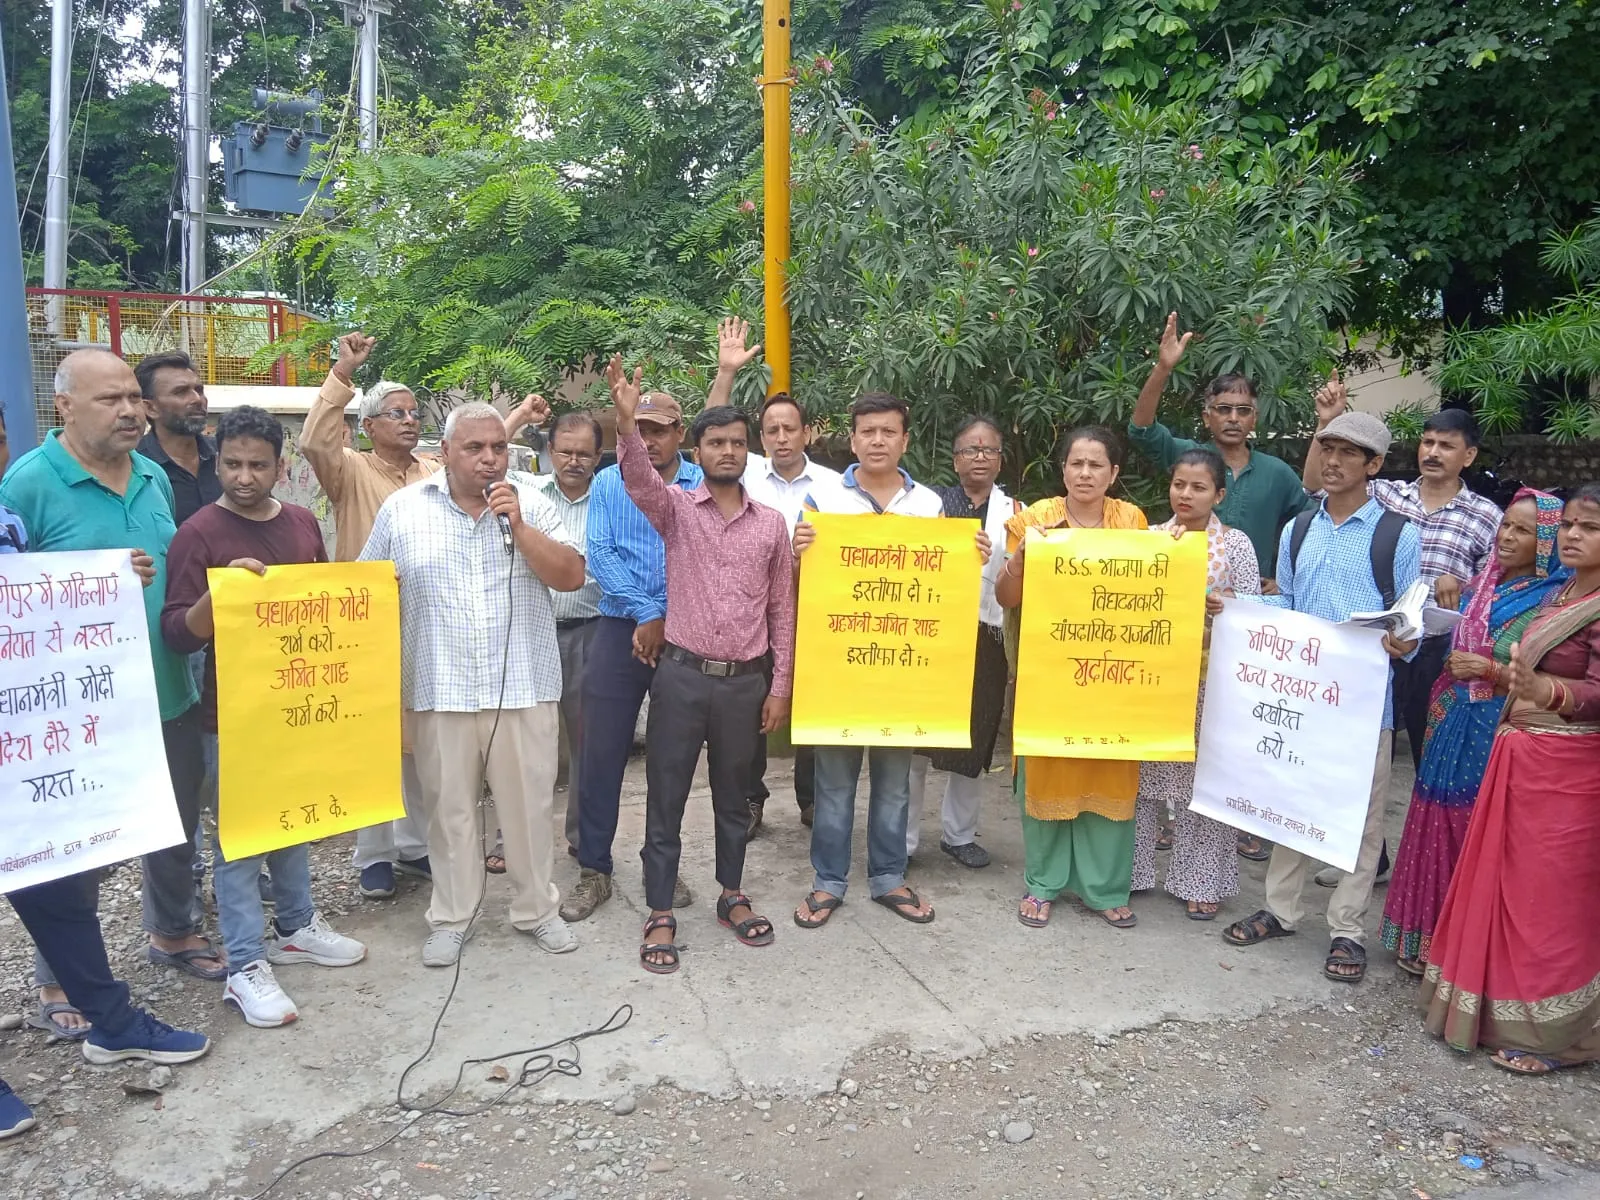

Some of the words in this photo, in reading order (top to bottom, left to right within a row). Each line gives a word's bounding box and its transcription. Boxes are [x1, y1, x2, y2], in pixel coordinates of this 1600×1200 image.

[840, 544, 909, 570] प्रधानमंत्री
[911, 545, 949, 572] मोदी
[1055, 556, 1093, 576] R.S.S.
[1098, 558, 1144, 578] भाजपा
[1147, 553, 1171, 579] की
[35, 573, 53, 610] में
[852, 577, 903, 602] इस्तीफा
[1091, 585, 1169, 612] विघटनकारी
[255, 591, 332, 628] प्रधानमंत्री
[336, 587, 373, 622] मोदी
[45, 621, 64, 653] से
[276, 625, 306, 656] शर्म
[827, 611, 872, 634] गृहमंत्री
[872, 613, 909, 636] अमित
[913, 619, 940, 638] शाह
[1050, 618, 1117, 643] सांप्रदायिक
[1120, 619, 1174, 646] राजनीति
[847, 642, 897, 666] इस्तीफा
[1246, 625, 1296, 662] मणिपुर
[1300, 637, 1321, 666] की
[75, 664, 115, 703] मोदी
[270, 658, 317, 690] अमित
[321, 661, 349, 685] शाह
[1236, 662, 1267, 688] राज्य
[1270, 672, 1320, 702] सरकार
[1322, 681, 1342, 707] को
[281, 694, 314, 727] शर्म
[1252, 698, 1304, 731] बर्खास्त
[43, 720, 71, 756] दौरे
[81, 714, 100, 746] में
